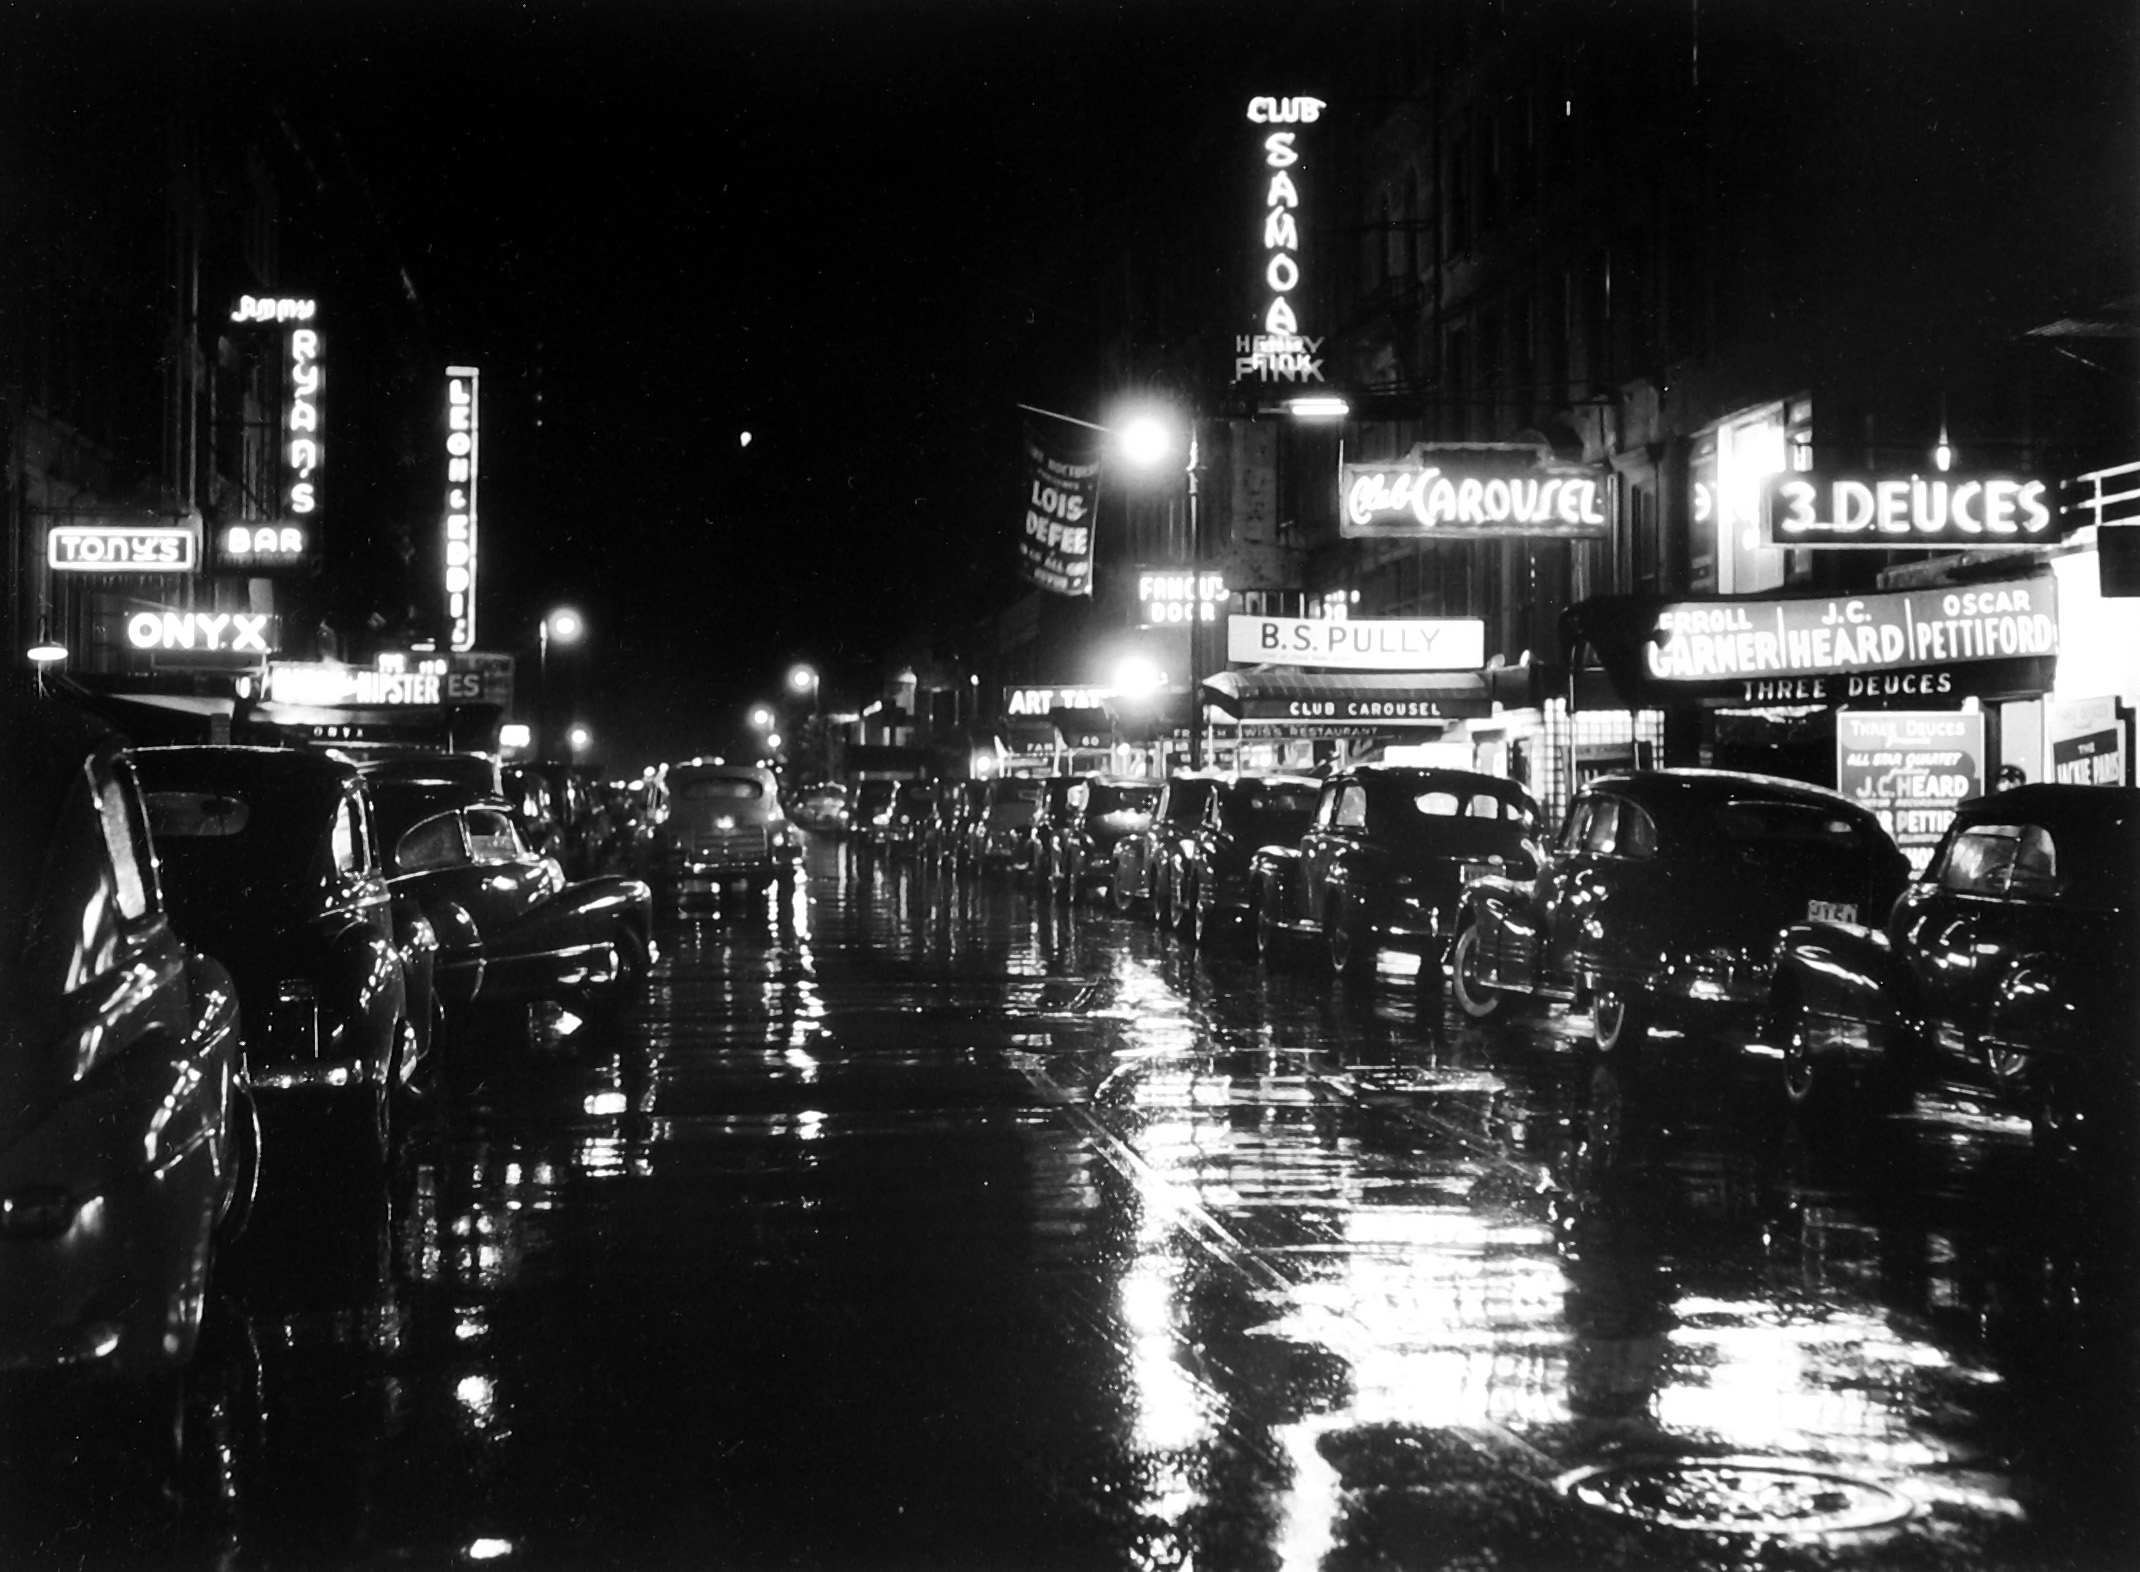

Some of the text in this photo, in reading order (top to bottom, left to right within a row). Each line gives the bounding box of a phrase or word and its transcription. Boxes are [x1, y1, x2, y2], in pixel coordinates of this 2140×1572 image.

[1247, 96, 1327, 123] CLUB
[1264, 132, 1299, 336] SAMOA
[446, 379, 471, 482] LEON
[1031, 479, 1088, 522] LOIS
[1411, 467, 1605, 527] CAROUSEL
[1780, 478, 2052, 533] 3 DEUCES
[226, 526, 303, 554] BAR
[1025, 508, 1089, 555] DEFEE
[1943, 590, 2031, 617] OSCAR
[127, 611, 270, 651] ONYX
[1659, 608, 1753, 635] ERROLL
[1327, 625, 1441, 653] PULLY
[1787, 621, 1905, 668] HEARD
[1917, 613, 2053, 661] PETTIFORD
[1648, 631, 1779, 678] GARNER
[1008, 690, 1054, 714] ART
[1742, 673, 1953, 702] THREE DEUCES
[1289, 702, 1442, 717] CLUB CAROUSEL
[1846, 752, 1870, 766] ALL
[1896, 774, 1970, 798] HEARD
[1896, 809, 1957, 833] PETTIF
